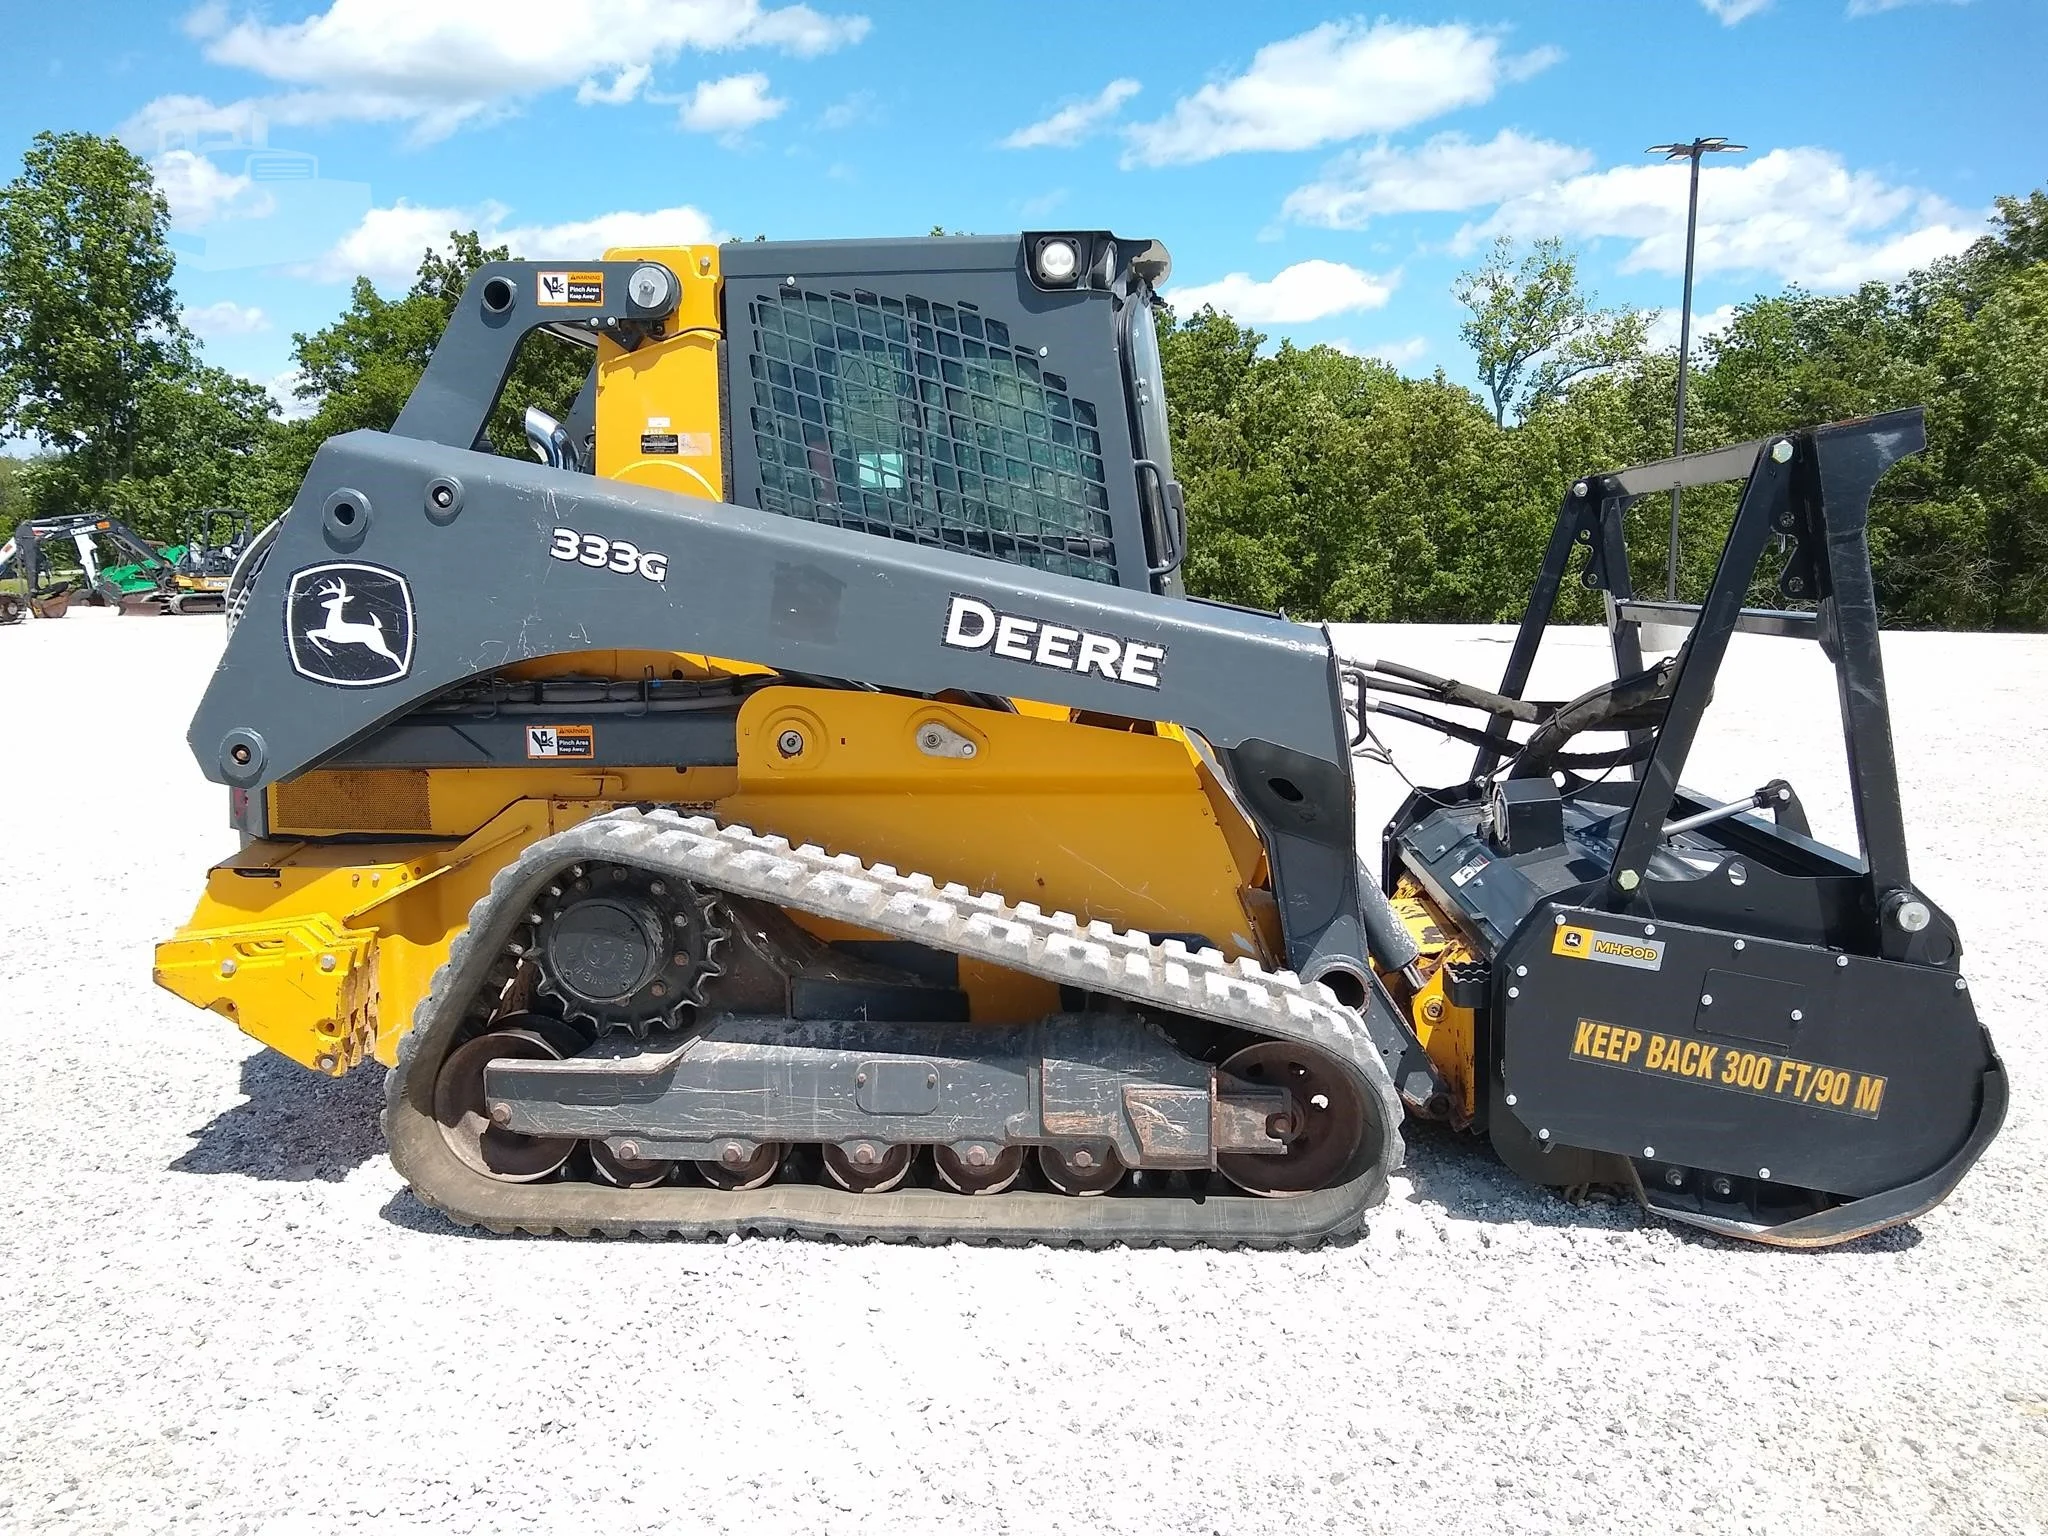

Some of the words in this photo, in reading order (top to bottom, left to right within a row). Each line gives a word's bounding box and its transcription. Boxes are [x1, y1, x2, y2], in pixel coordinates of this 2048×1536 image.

[549, 527, 668, 583] 333G
[944, 595, 1165, 689] DEERE
[1595, 940, 1658, 961] MH60D
[1573, 1021, 1642, 1063] KEEP
[1645, 1035, 1719, 1080] BACK
[1721, 1050, 1772, 1090] 300
[1775, 1060, 1850, 1105] FT/90
[1854, 1076, 1884, 1112] M
